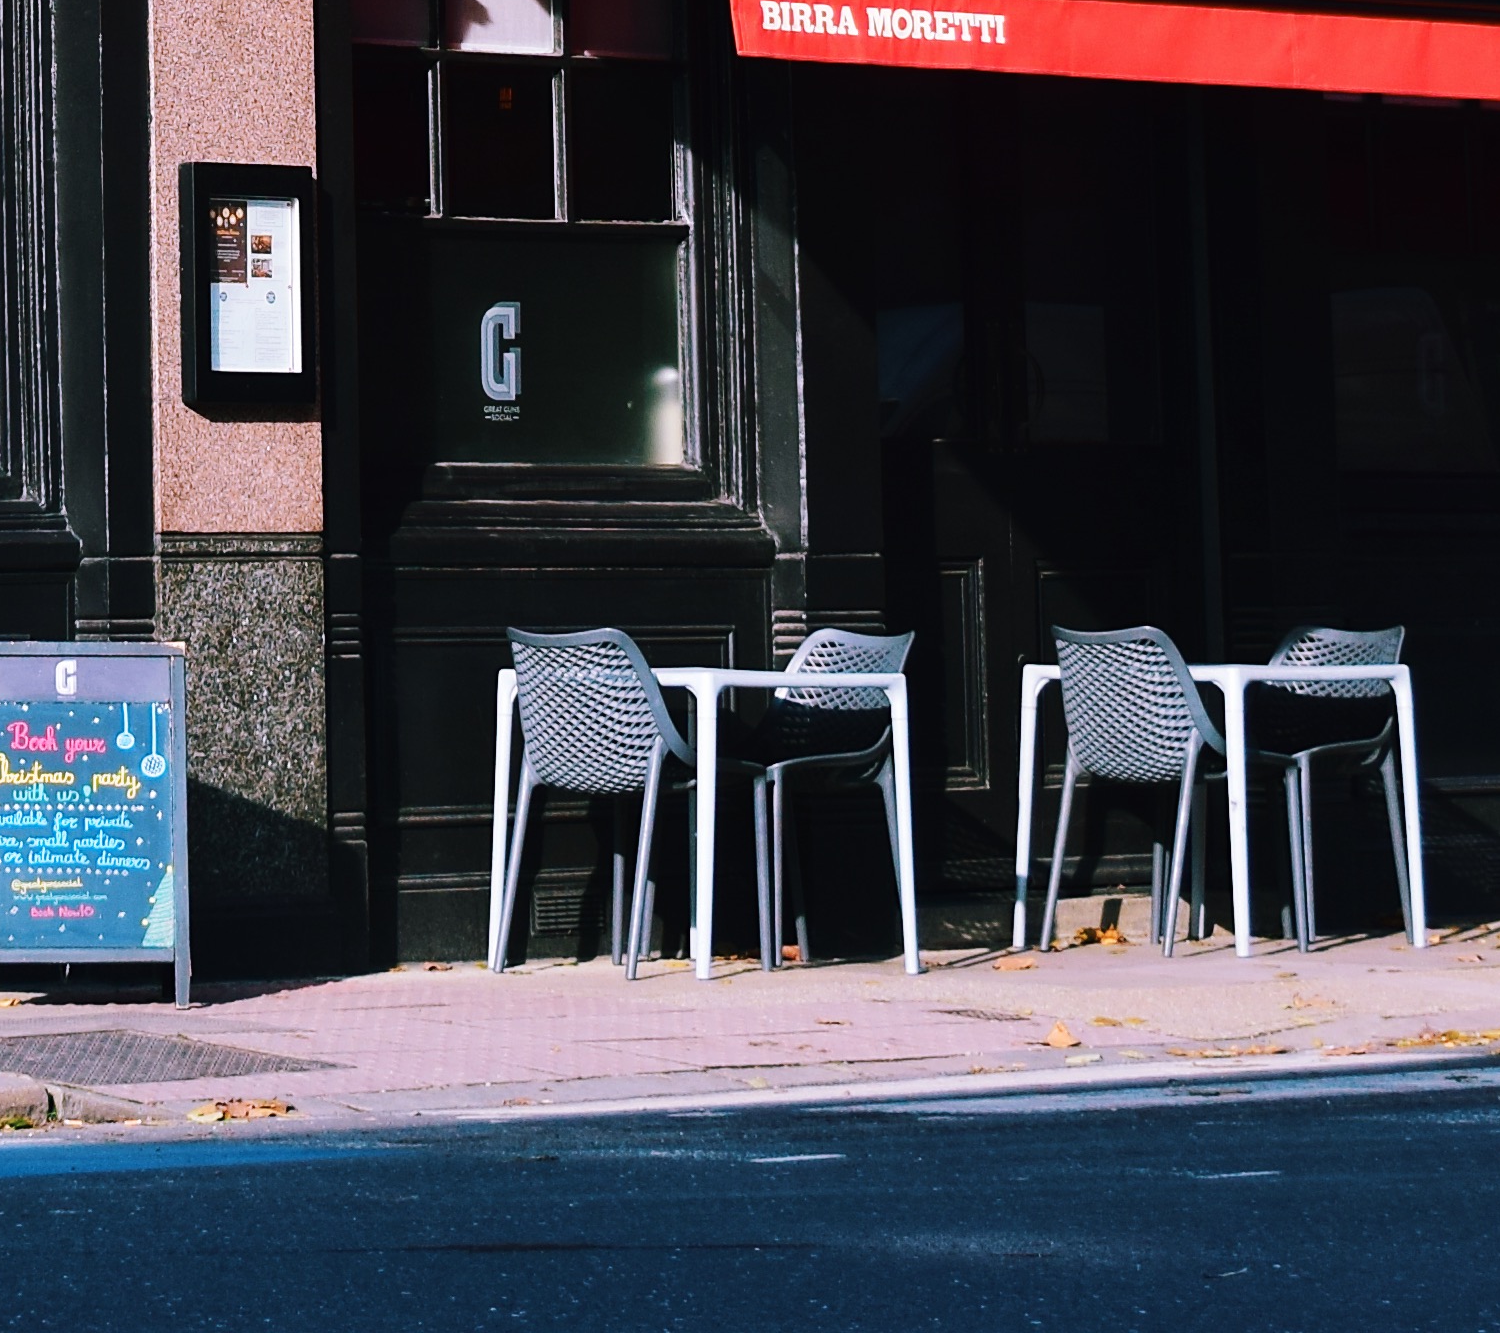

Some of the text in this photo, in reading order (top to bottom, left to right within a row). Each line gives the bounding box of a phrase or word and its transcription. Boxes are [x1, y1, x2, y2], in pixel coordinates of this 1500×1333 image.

[760, 0, 1006, 45] BIRRA MORETTI
[7, 720, 106, 764] Book your
[93, 765, 141, 799] party
[13, 786, 49, 802] with
[53, 812, 78, 831] for
[85, 812, 133, 831] private
[27, 831, 69, 847] small
[73, 829, 125, 851] parties
[4, 847, 150, 870] or intimate dinners
